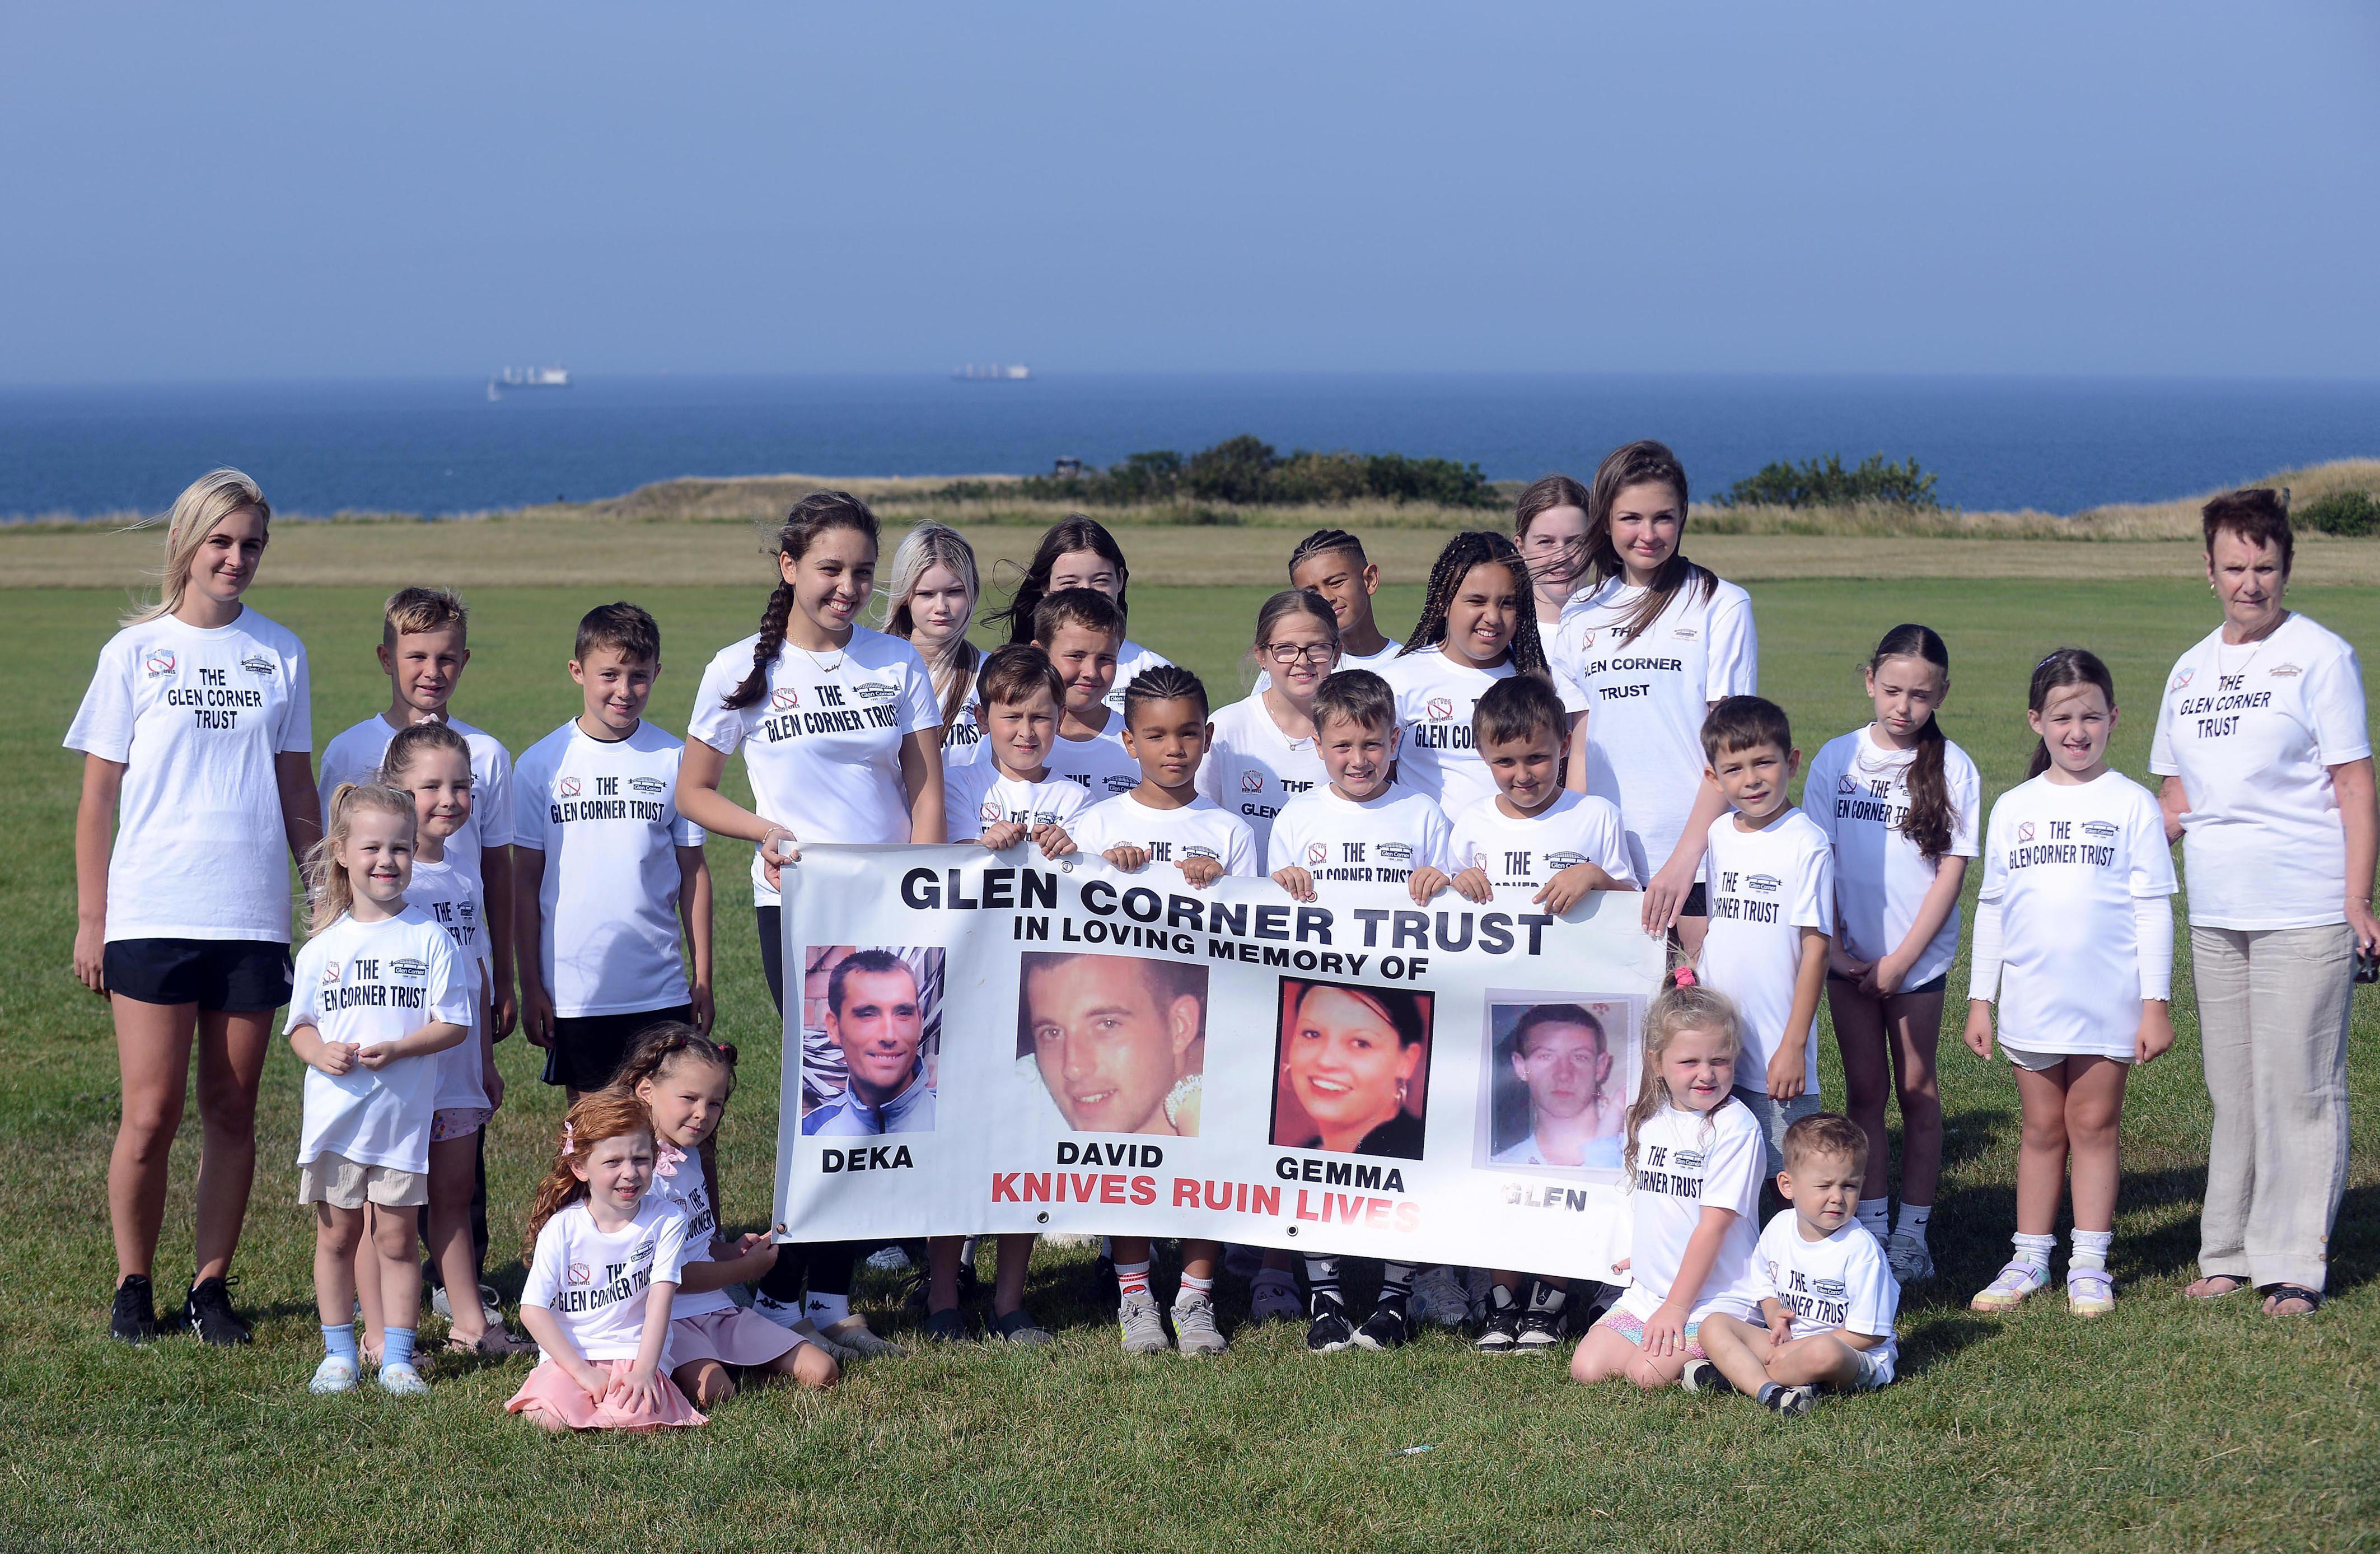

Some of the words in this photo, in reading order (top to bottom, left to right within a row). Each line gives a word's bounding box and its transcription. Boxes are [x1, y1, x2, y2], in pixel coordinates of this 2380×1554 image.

[1612, 657, 1682, 671] CORNER
[199, 669, 226, 686] THE
[2218, 675, 2245, 692] THE
[168, 689, 203, 706] GLEN
[207, 689, 263, 707] CORNER
[815, 685, 845, 707] THE
[1599, 684, 1650, 700] TRUST
[2180, 697, 2214, 715] GLEN
[2216, 692, 2271, 711] CORNER
[195, 710, 237, 729] TRUST
[765, 715, 802, 743] GLEN
[805, 710, 864, 734] CORNER
[2197, 716, 2239, 738] TRUST
[1415, 724, 1447, 749] GLEN
[596, 777, 618, 795] THE
[1869, 780, 1891, 799] THE
[550, 802, 578, 824] GLEN
[581, 800, 626, 820] CORNER
[630, 800, 665, 822] TRUST
[1241, 803, 1281, 819] GLEN
[1837, 799, 1850, 818] EN
[1851, 800, 1892, 823] CORNER
[2050, 821, 2071, 839] THE
[1149, 842, 1172, 862] THE
[1343, 843, 1366, 862] THE
[1505, 852, 1531, 875] THE
[2009, 847, 2031, 870] GLEN
[2033, 844, 2076, 864] CORNER
[2080, 845, 2115, 866] TRUST
[1722, 871, 1738, 892] THE
[433, 901, 452, 923] THE
[901, 867, 1057, 909] GLEN
[1081, 880, 1334, 945] CORNER
[1354, 909, 1554, 955] TRUST
[1743, 899, 1779, 923] TRUST
[1014, 916, 1049, 941] IN
[1063, 917, 1195, 955] LOVING
[1207, 939, 1369, 976] MEMORY
[1380, 955, 1429, 981] OF
[356, 959, 379, 980] THE
[324, 989, 338, 1011] EN
[340, 985, 386, 1009] CORNER
[390, 986, 426, 1009] TRUST
[822, 1145, 914, 1173] DEKA
[1057, 1142, 1163, 1168] DAVID
[1648, 1146, 1667, 1167] THE
[1275, 1157, 1405, 1193] GEMMA
[1671, 1174, 1703, 1199] TRUST
[688, 1188, 705, 1212] THE
[992, 1172, 1157, 1206] KNIVES
[1172, 1178, 1280, 1216] RUIN
[1296, 1189, 1420, 1233] LIVES
[1501, 1182, 1587, 1212] GLEN
[1789, 1270, 1808, 1293] THE
[559, 1291, 586, 1312] GLEN
[591, 1278, 633, 1309] CORNER
